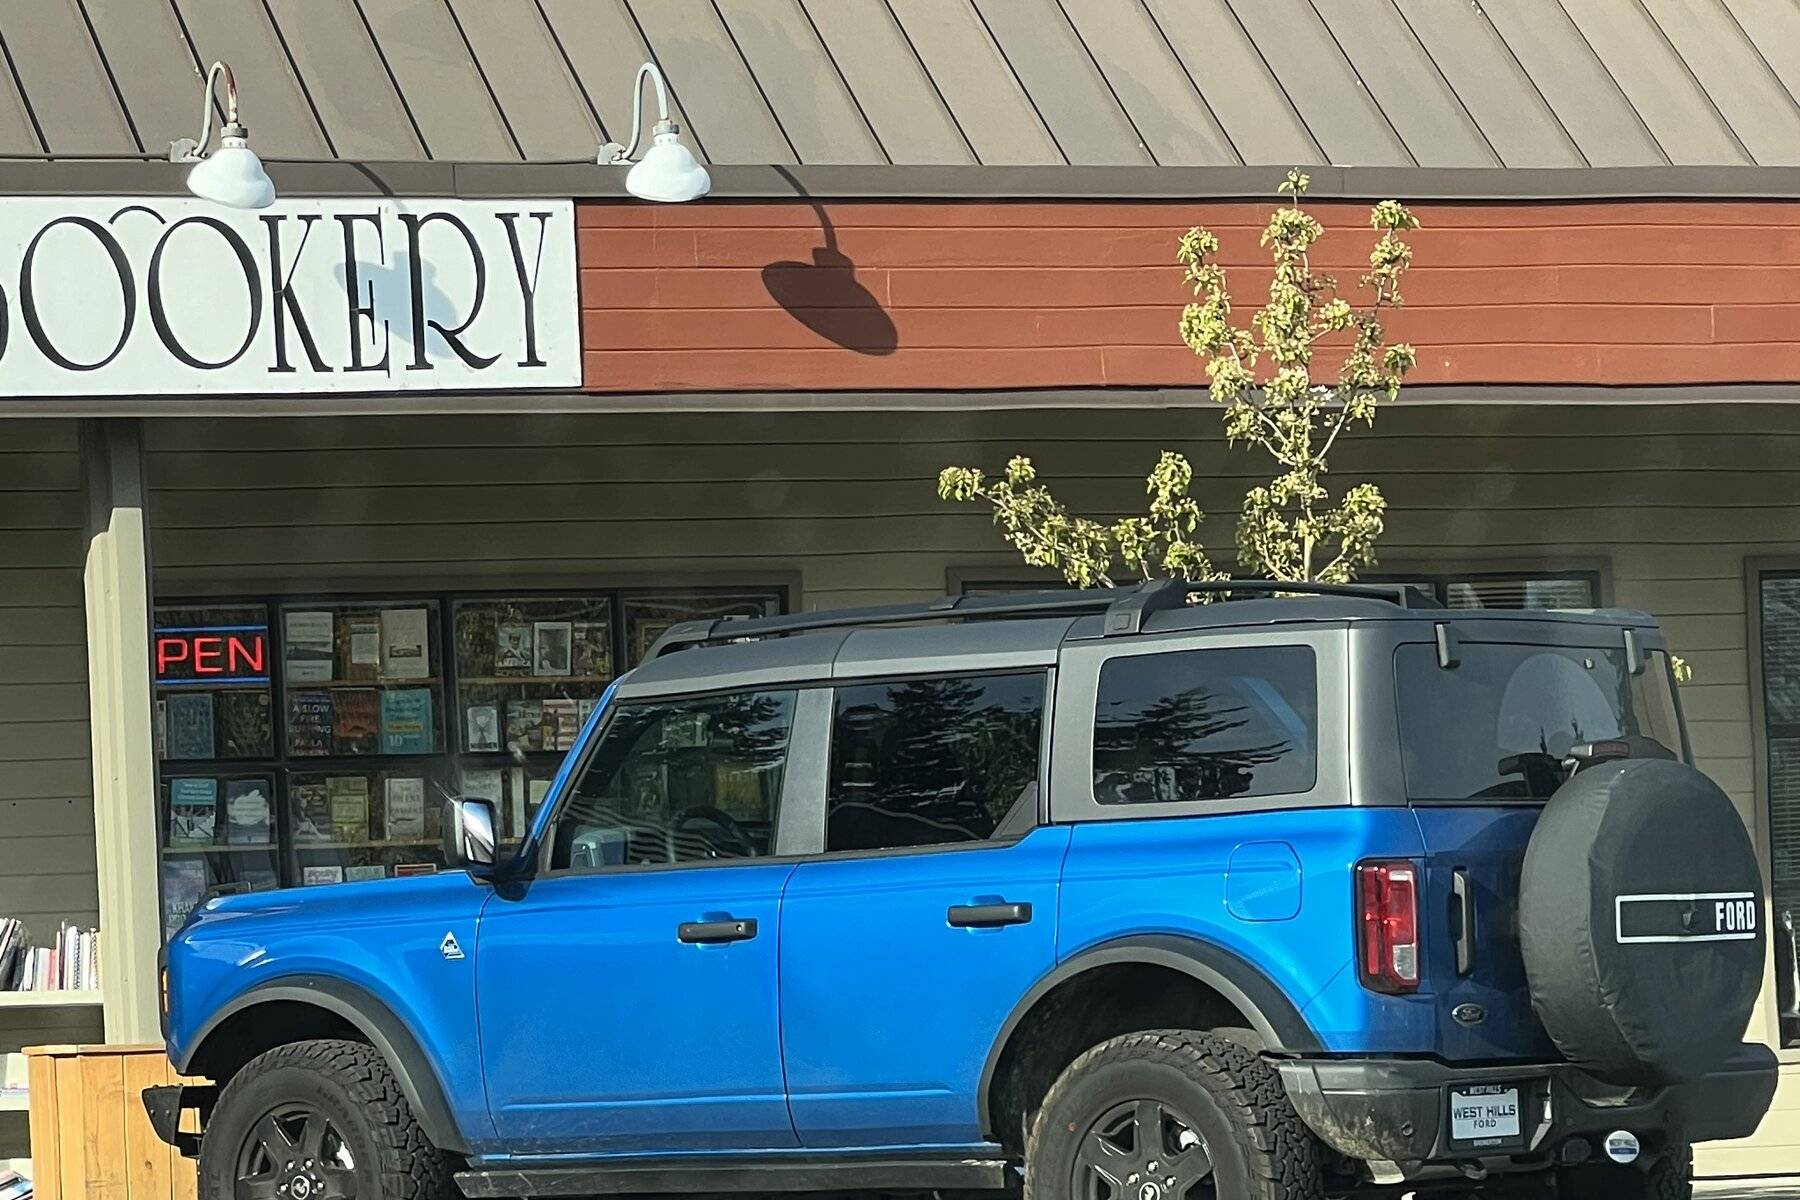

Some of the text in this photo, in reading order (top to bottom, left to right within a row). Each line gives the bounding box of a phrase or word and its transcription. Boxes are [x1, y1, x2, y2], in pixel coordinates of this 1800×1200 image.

[0, 205, 553, 378] OOKERY
[156, 635, 264, 673] PEN
[1715, 900, 1756, 932] FORD
[1454, 1104, 1516, 1119] WEST HILLS
[1474, 1119, 1497, 1128] FORD
